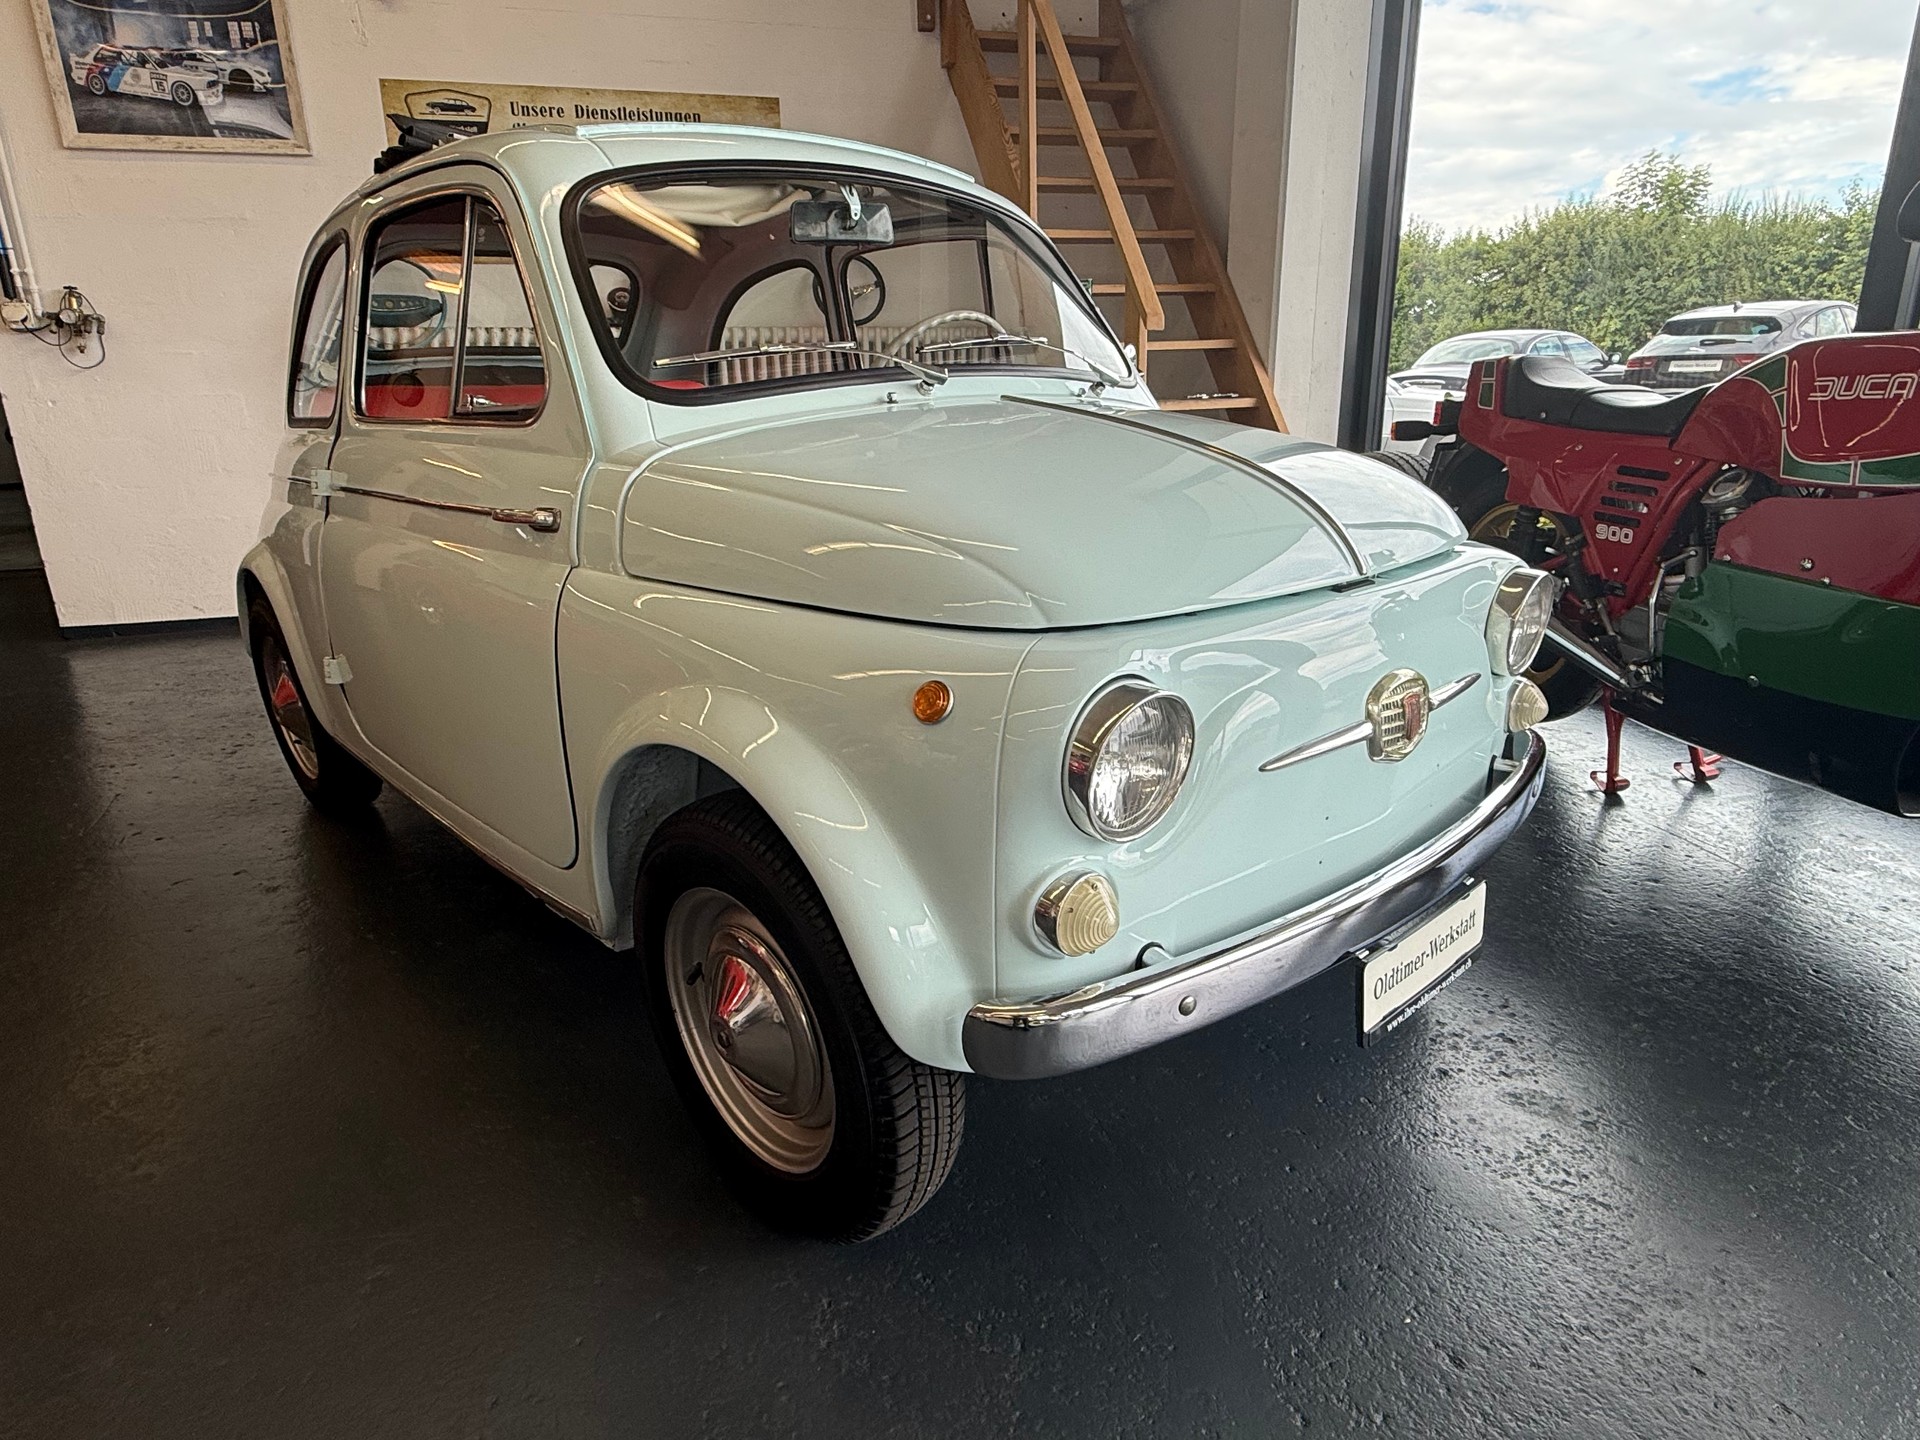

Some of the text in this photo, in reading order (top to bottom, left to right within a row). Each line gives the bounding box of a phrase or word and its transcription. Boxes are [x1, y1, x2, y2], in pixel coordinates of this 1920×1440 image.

[155, 81, 166, 92] 15
[510, 101, 702, 123] Unsere Dienstleistungen
[1807, 373, 1920, 400] DUCA
[1595, 523, 1634, 544] 900
[1373, 909, 1477, 1000] Oldtimer-Werkstatt
